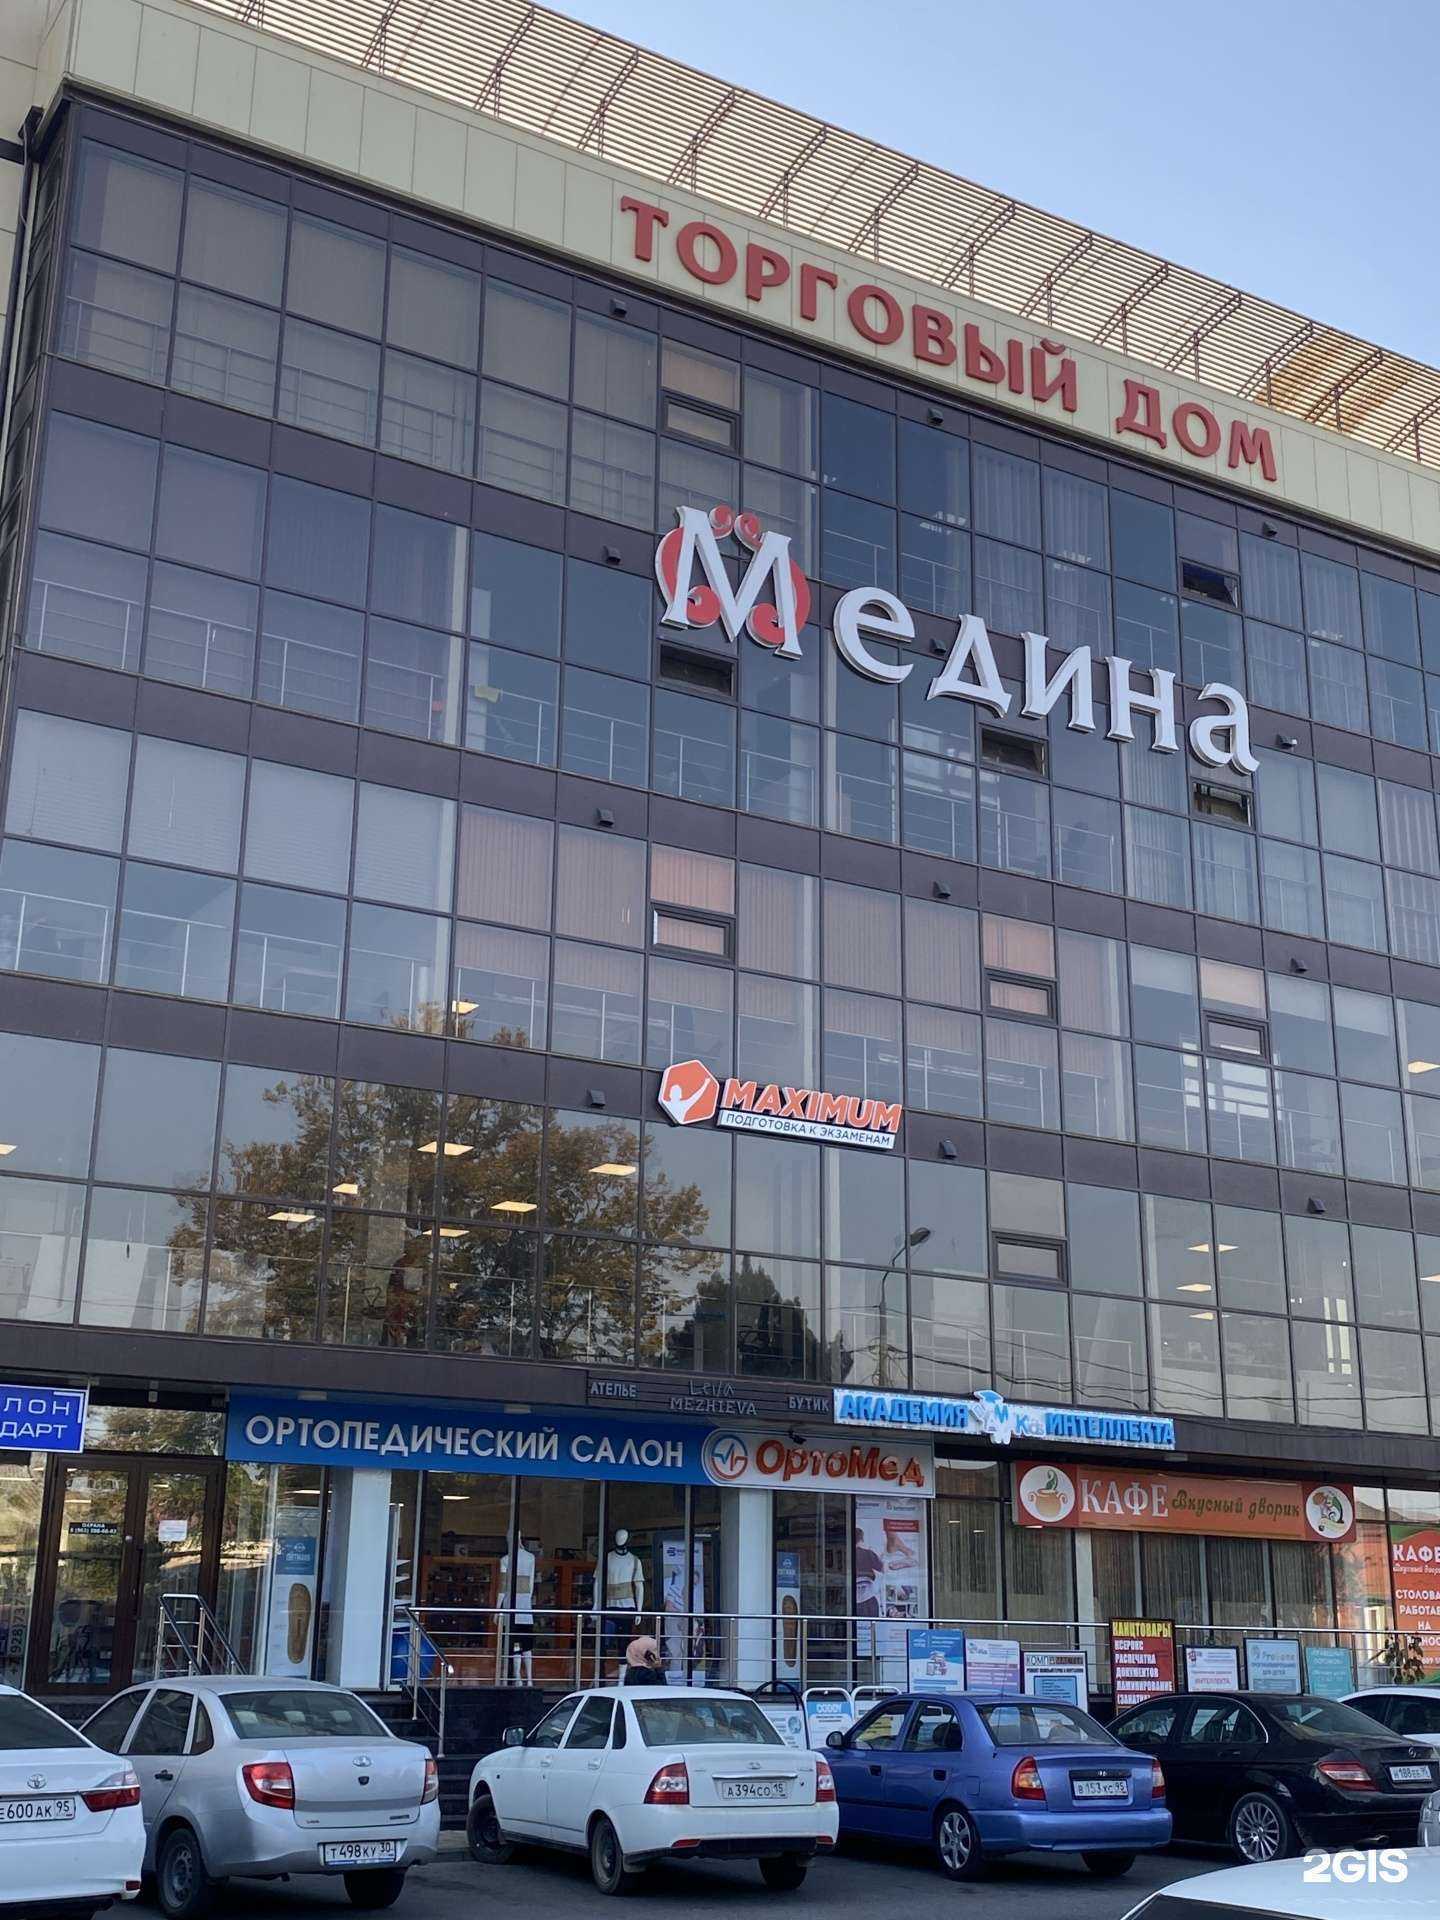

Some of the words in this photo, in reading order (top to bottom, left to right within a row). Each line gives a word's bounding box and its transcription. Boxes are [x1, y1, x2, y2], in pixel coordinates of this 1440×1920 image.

[620, 195, 1078, 413] ТОРГОВЫЙ
[1116, 379, 1278, 482] ДОМ
[655, 504, 1260, 776] Медина
[722, 1077, 903, 1134] MAXIMUM
[726, 1113, 807, 1134] ПОДГОТОВКА
[809, 1125, 817, 1136] К
[819, 1127, 891, 1146] ЭКЗАМЕНАМ
[590, 1381, 637, 1398] АТЕЛЬЕ
[669, 1397, 758, 1415] MEZHIEVA
[788, 1396, 830, 1412] БУТИК
[839, 1394, 969, 1428] АКАДЕМИЯ
[1045, 1413, 1175, 1445] ИНТЕЛЛЕКТА
[245, 1414, 559, 1461] ОРТОПЕДИЧЕСКИЙ
[570, 1434, 683, 1467] САЛОН
[755, 1439, 925, 1487] ОртоМед
[1080, 1478, 1169, 1518] КАФЕ
[1171, 1488, 1243, 1518] Вкусный
[1248, 1497, 1300, 1522] дворик
[1112, 1621, 1172, 1638] КАНЦТОВАРЫ
[1417, 1620, 1432, 1631] НА
[1114, 1640, 1144, 1651] КСЕРОКС
[1115, 1653, 1157, 1665] РАСПЕЧАТКА
[1115, 1667, 1159, 1680] ДОКУМЕНТОВ
[1116, 1680, 1173, 1692] ЛАМИНИРОВАНИЕ
[727, 1784, 771, 1797] А394СО
[773, 1783, 784, 1793] 15
[56, 1800, 70, 1813] 95
[330, 1844, 377, 1859] Т498КУ
[380, 1841, 392, 1853] 30
